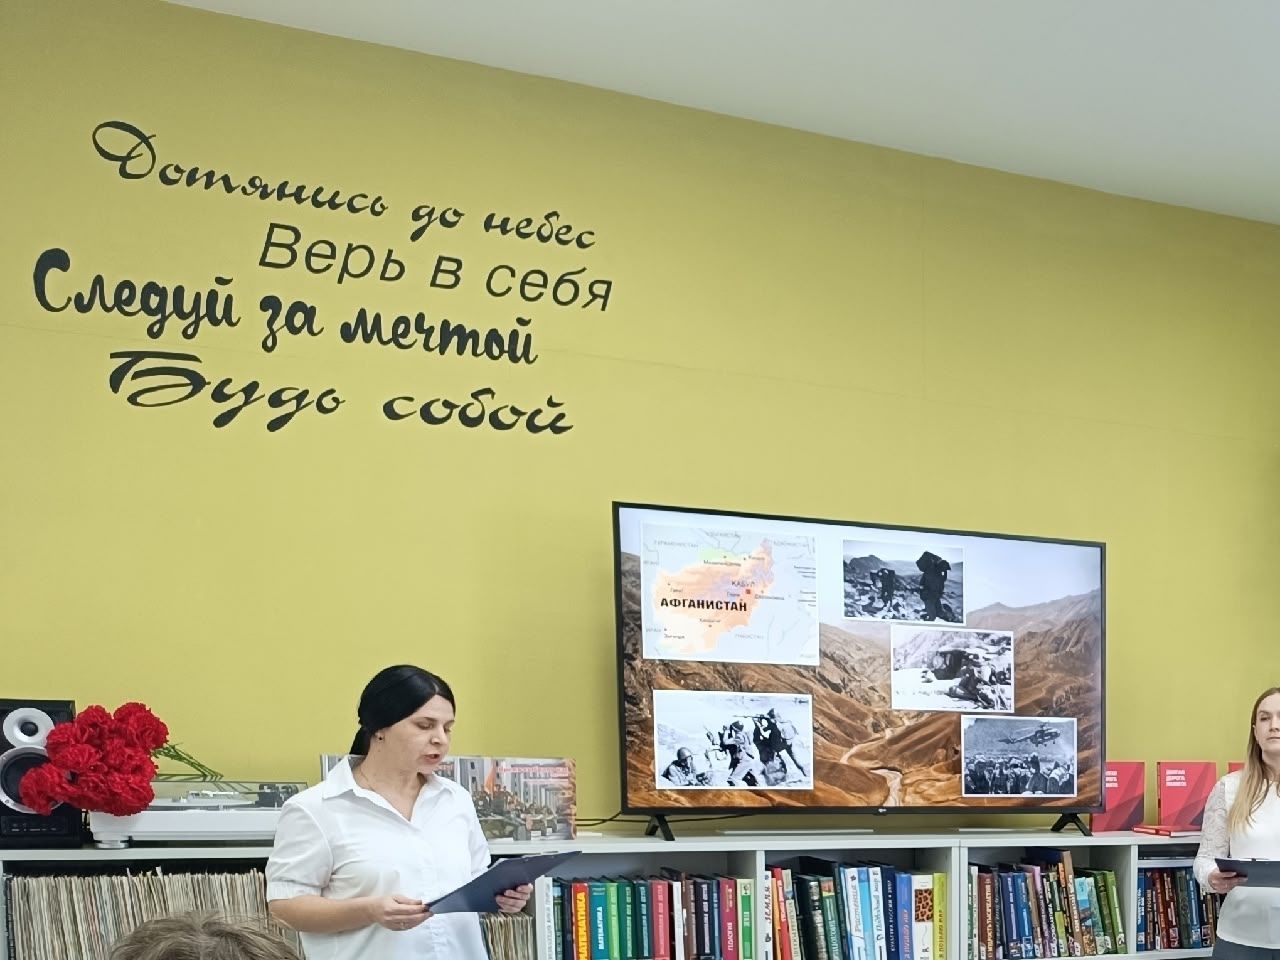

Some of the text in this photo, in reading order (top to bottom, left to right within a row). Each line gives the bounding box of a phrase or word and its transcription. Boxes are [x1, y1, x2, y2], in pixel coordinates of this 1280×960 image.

[92, 121, 596, 249] Дотянись до небес
[33, 247, 539, 365] Следуй за мечтой
[259, 222, 613, 312] Верь в себя
[109, 350, 574, 435] Будь собой
[660, 597, 748, 612] АФГАНИСТАН
